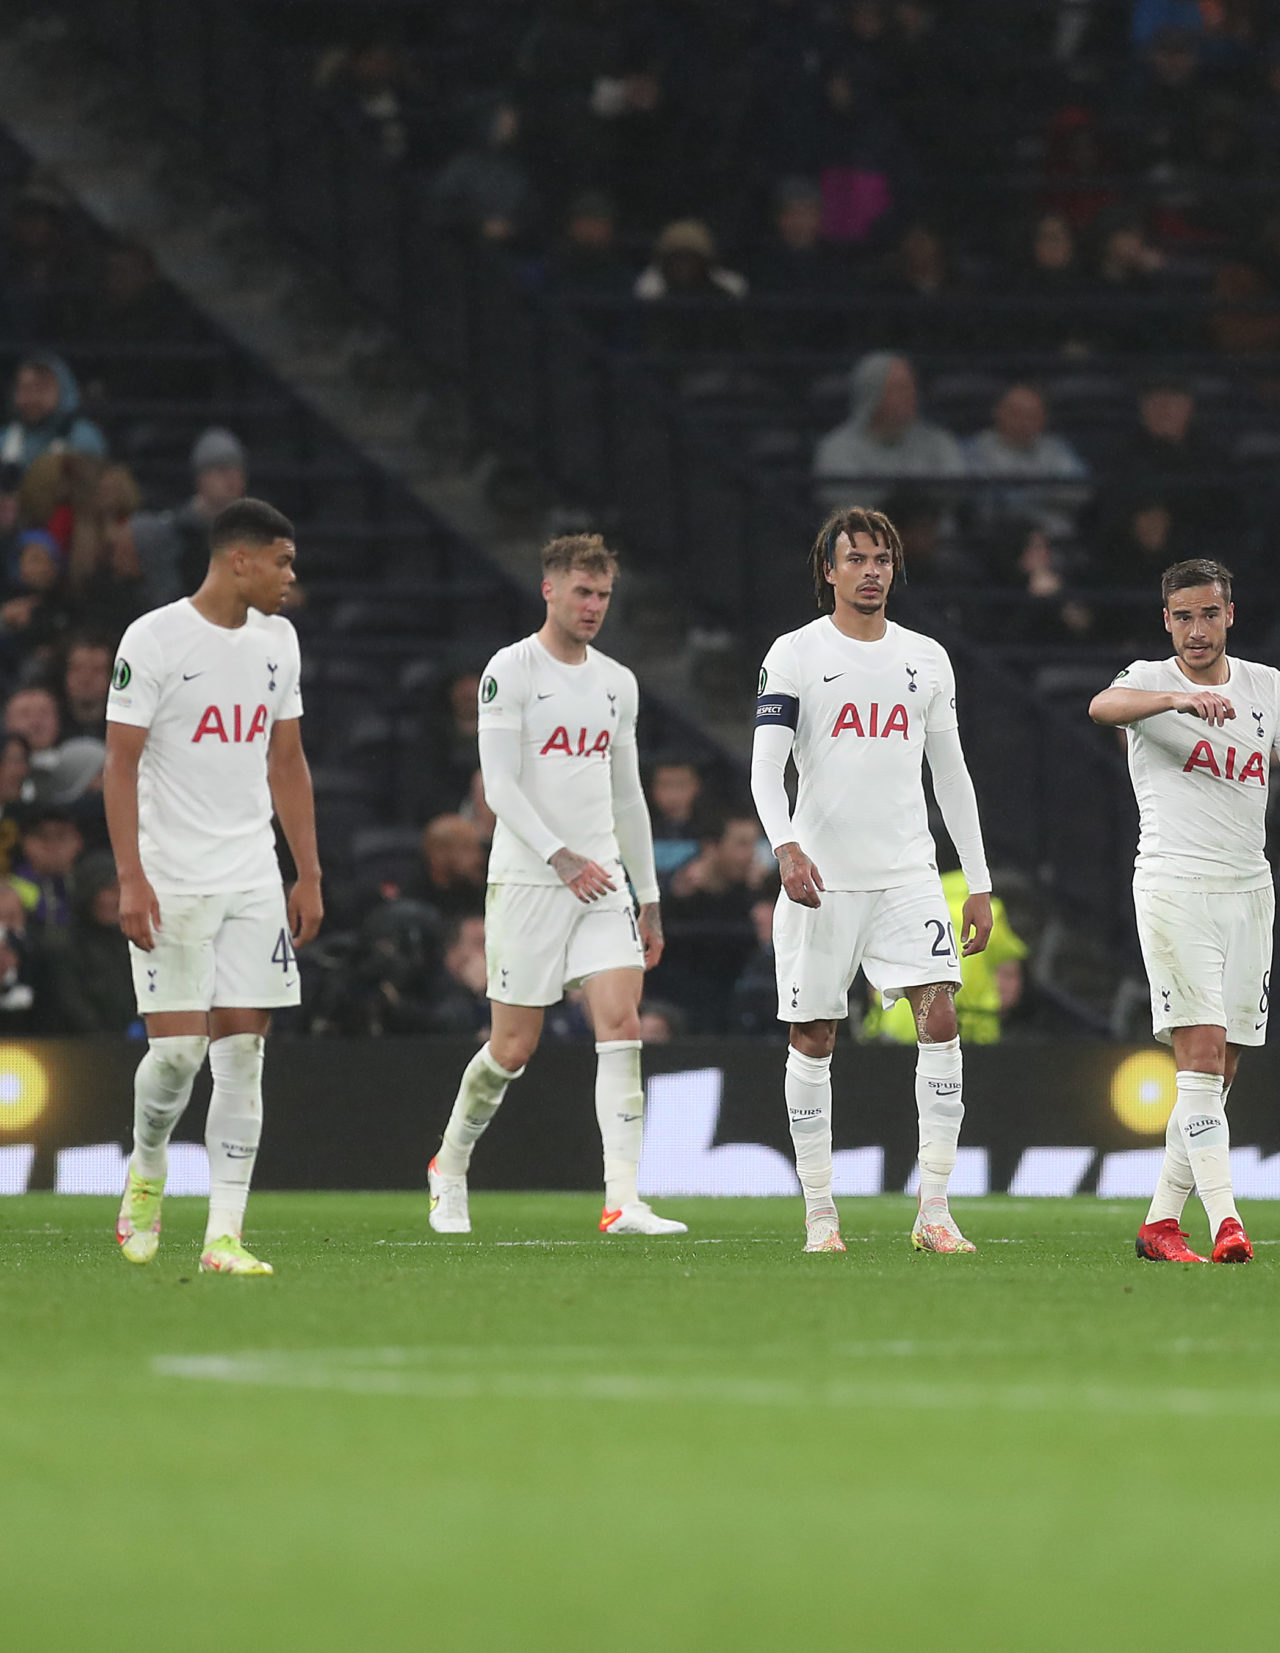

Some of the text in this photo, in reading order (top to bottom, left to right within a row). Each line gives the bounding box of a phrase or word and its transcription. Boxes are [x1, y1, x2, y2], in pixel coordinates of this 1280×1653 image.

[191, 704, 267, 743] AIA
[831, 702, 909, 740] AIA
[540, 726, 610, 759] AIA
[1183, 740, 1265, 785] AIA
[928, 1081, 961, 1089] SPUR
[790, 1107, 822, 1116] SPURS
[1184, 1119, 1221, 1133] SPURS
